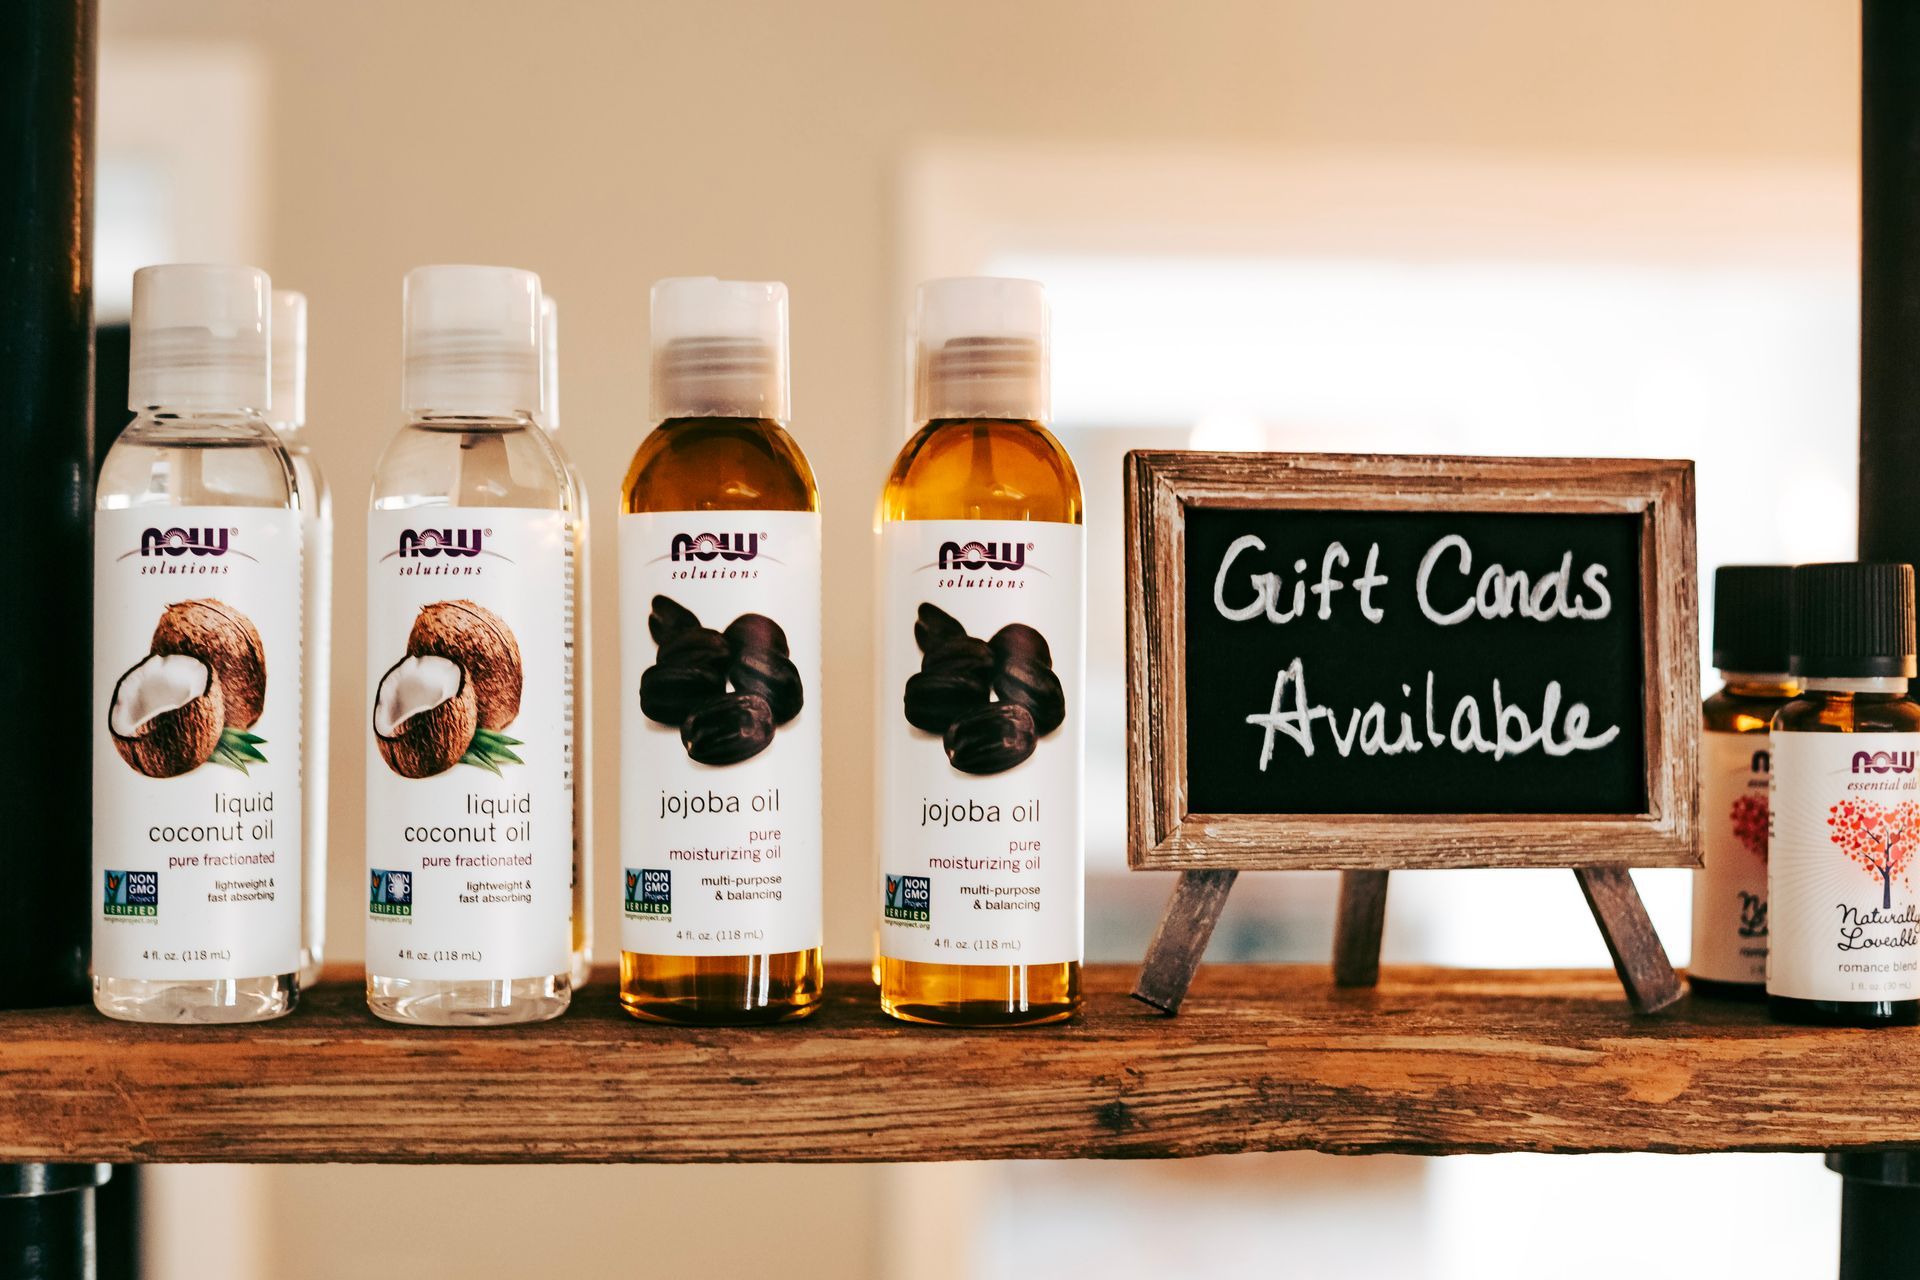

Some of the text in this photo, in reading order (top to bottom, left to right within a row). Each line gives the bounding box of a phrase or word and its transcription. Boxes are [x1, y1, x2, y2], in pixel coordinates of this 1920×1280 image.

[141, 561, 229, 575] solutions
[399, 562, 483, 576] solutions
[671, 566, 759, 580] solutions
[938, 575, 1025, 589] solutions
[1213, 534, 1389, 624] Gift
[1245, 657, 1620, 771] Available
[1847, 776, 1918, 791] essential oils
[215, 792, 274, 817] liquid
[467, 793, 531, 818] liquid
[660, 788, 780, 819] jojoba oil
[921, 797, 1040, 827] jojoba oil
[149, 819, 274, 842] coconut oil
[404, 821, 531, 843] coconut oil
[749, 829, 781, 844] pure
[1009, 840, 1041, 854] pure
[168, 852, 275, 869] pure fractionated
[422, 853, 532, 869] pure fractionated
[669, 846, 781, 863] moisturizing oil
[929, 856, 1041, 873] moisturizing oil
[129, 874, 155, 884] NON
[645, 872, 669, 882] NON
[701, 875, 782, 887] multi-purpose
[129, 884, 156, 895] GMO
[215, 878, 275, 890] lightweight &
[388, 884, 410, 894] GO
[466, 880, 532, 892] lightweight &
[645, 882, 670, 893] GMO
[904, 878, 928, 890] NON
[960, 884, 1041, 896] multi-purpose
[207, 891, 275, 903] fast absorbing
[459, 892, 532, 904] fast absorbing
[715, 889, 782, 901] & balancing
[904, 889, 929, 900] GMO
[105, 905, 156, 916] VERIFIED
[626, 901, 670, 913] VERIFIED
[973, 899, 1041, 912] & balancing
[886, 908, 928, 921] VERIFIED
[1836, 903, 1920, 934] Naturally
[676, 931, 682, 940] 4
[716, 930, 741, 942] (118
[1837, 927, 1918, 952] Loveable
[934, 938, 941, 948] 4
[973, 939, 999, 951] (118
[143, 950, 149, 960] 4
[182, 950, 207, 962] (118
[398, 949, 404, 958] 4
[433, 951, 458, 962] (118
[1838, 960, 1918, 973] romance blend
